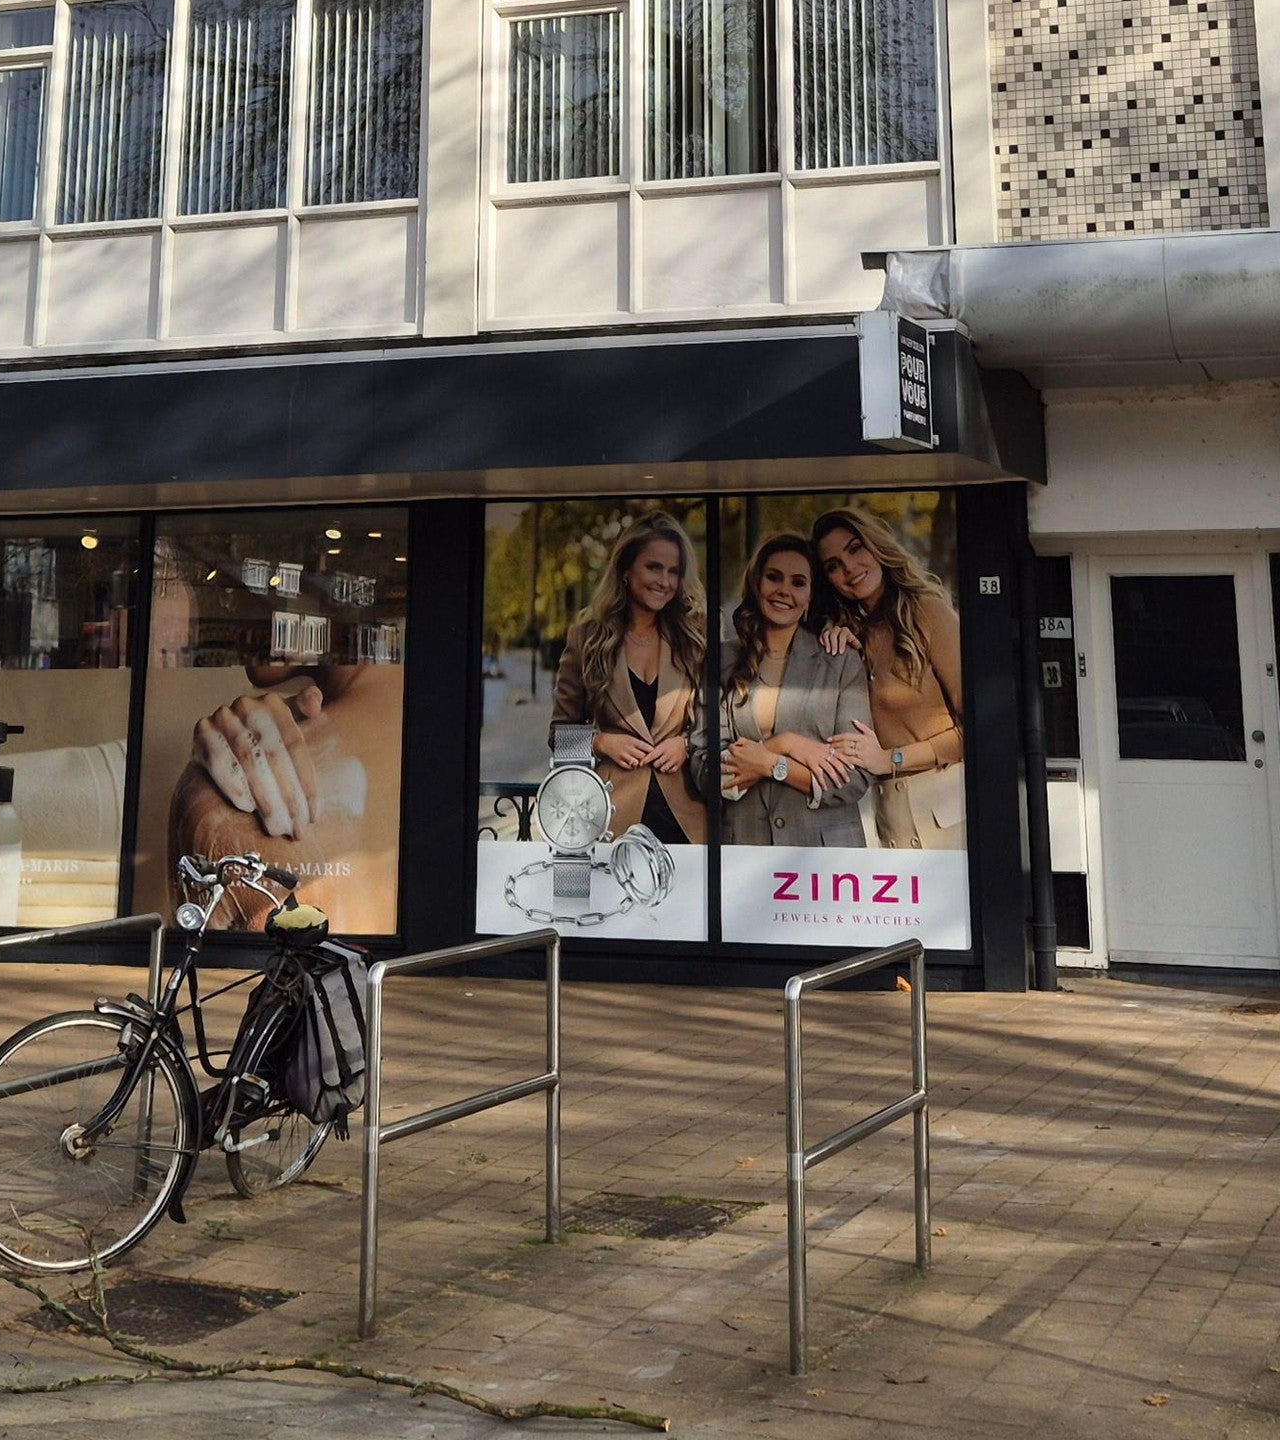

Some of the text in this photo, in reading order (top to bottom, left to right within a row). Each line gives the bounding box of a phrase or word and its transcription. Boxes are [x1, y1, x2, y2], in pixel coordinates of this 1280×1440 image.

[900, 351, 926, 383] POUR
[901, 378, 927, 410] VOUS
[981, 580, 999, 594] 38
[772, 912, 922, 926] JEWELS & WATCHES
